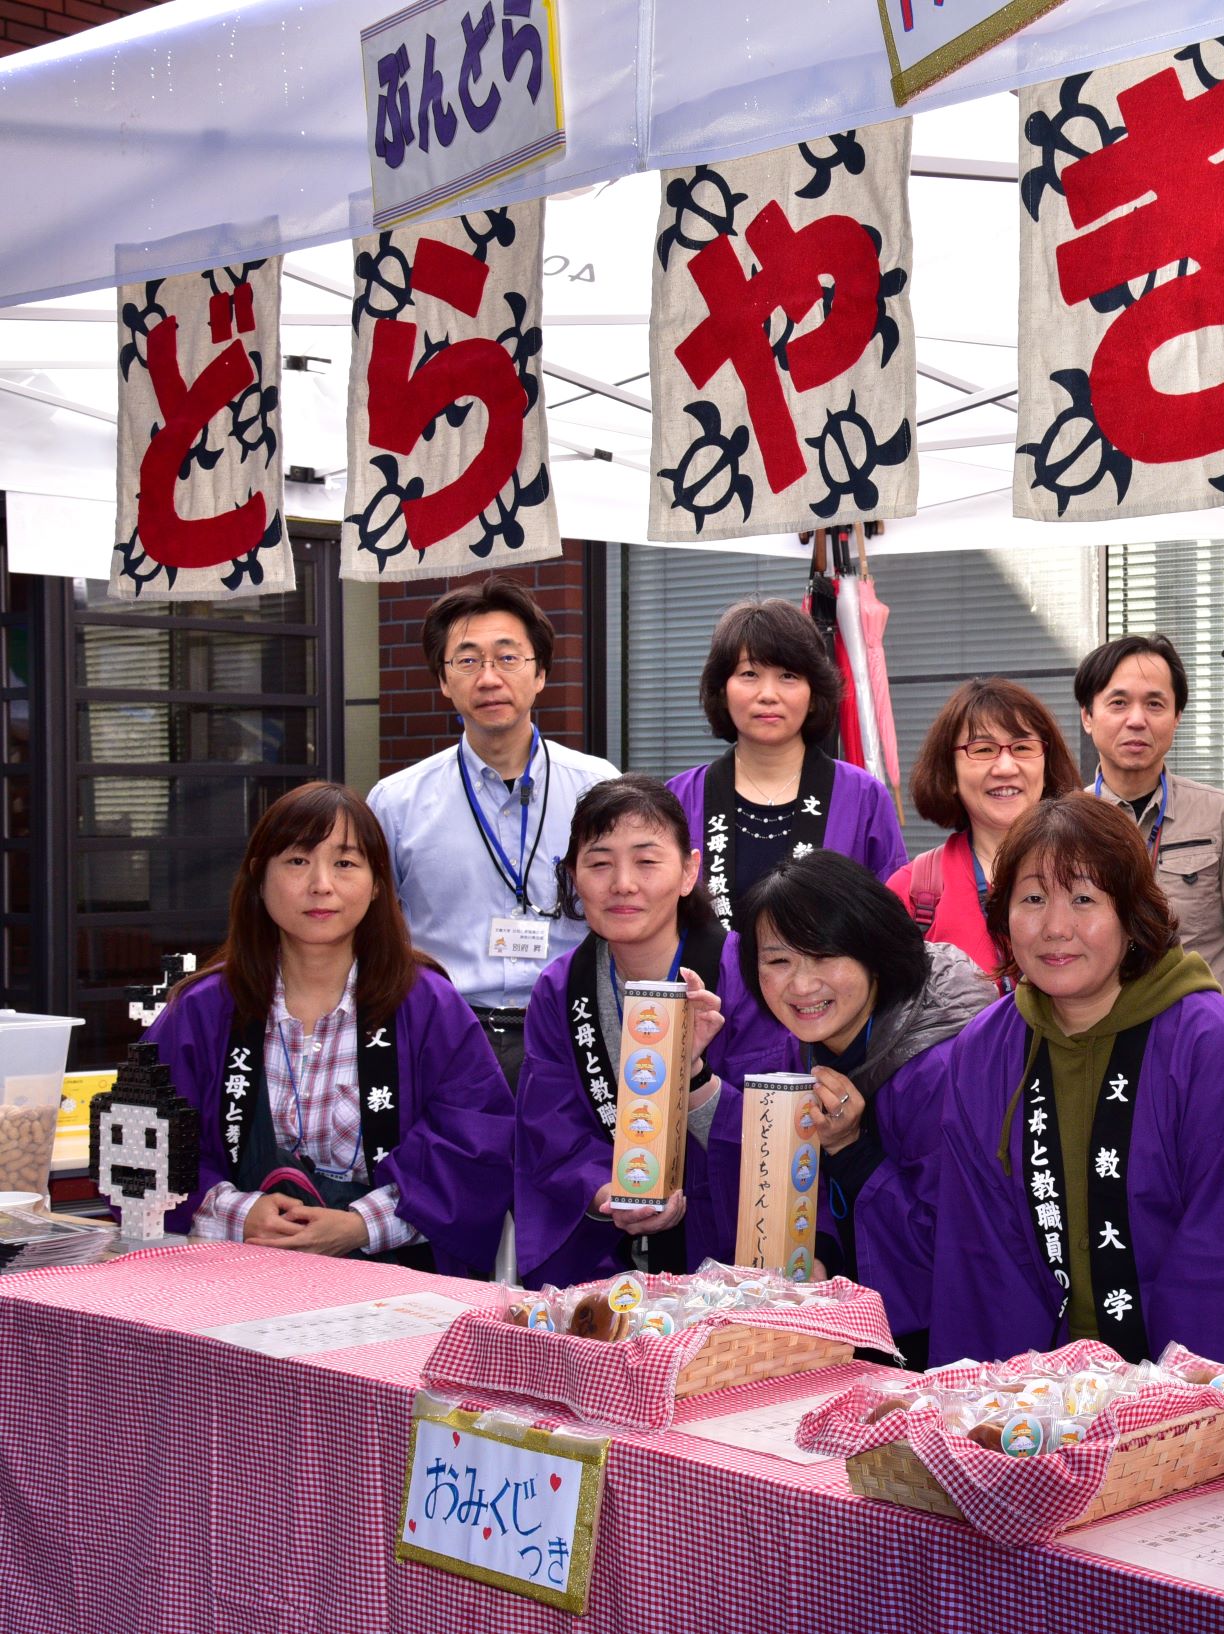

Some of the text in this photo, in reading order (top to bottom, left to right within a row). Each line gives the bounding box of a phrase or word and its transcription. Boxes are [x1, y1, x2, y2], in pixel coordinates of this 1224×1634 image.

[375, 0, 543, 169] ぶんどら
[137, 283, 266, 568] ど
[368, 238, 527, 551] ら
[675, 200, 880, 494] や
[571, 997, 617, 1140] 父母と教職
[754, 1091, 775, 1209] ぶんどらちゃん
[1095, 1073, 1133, 1322] 文教大学
[424, 1457, 543, 1536] おみくじ
[517, 1536, 570, 1586] つき
